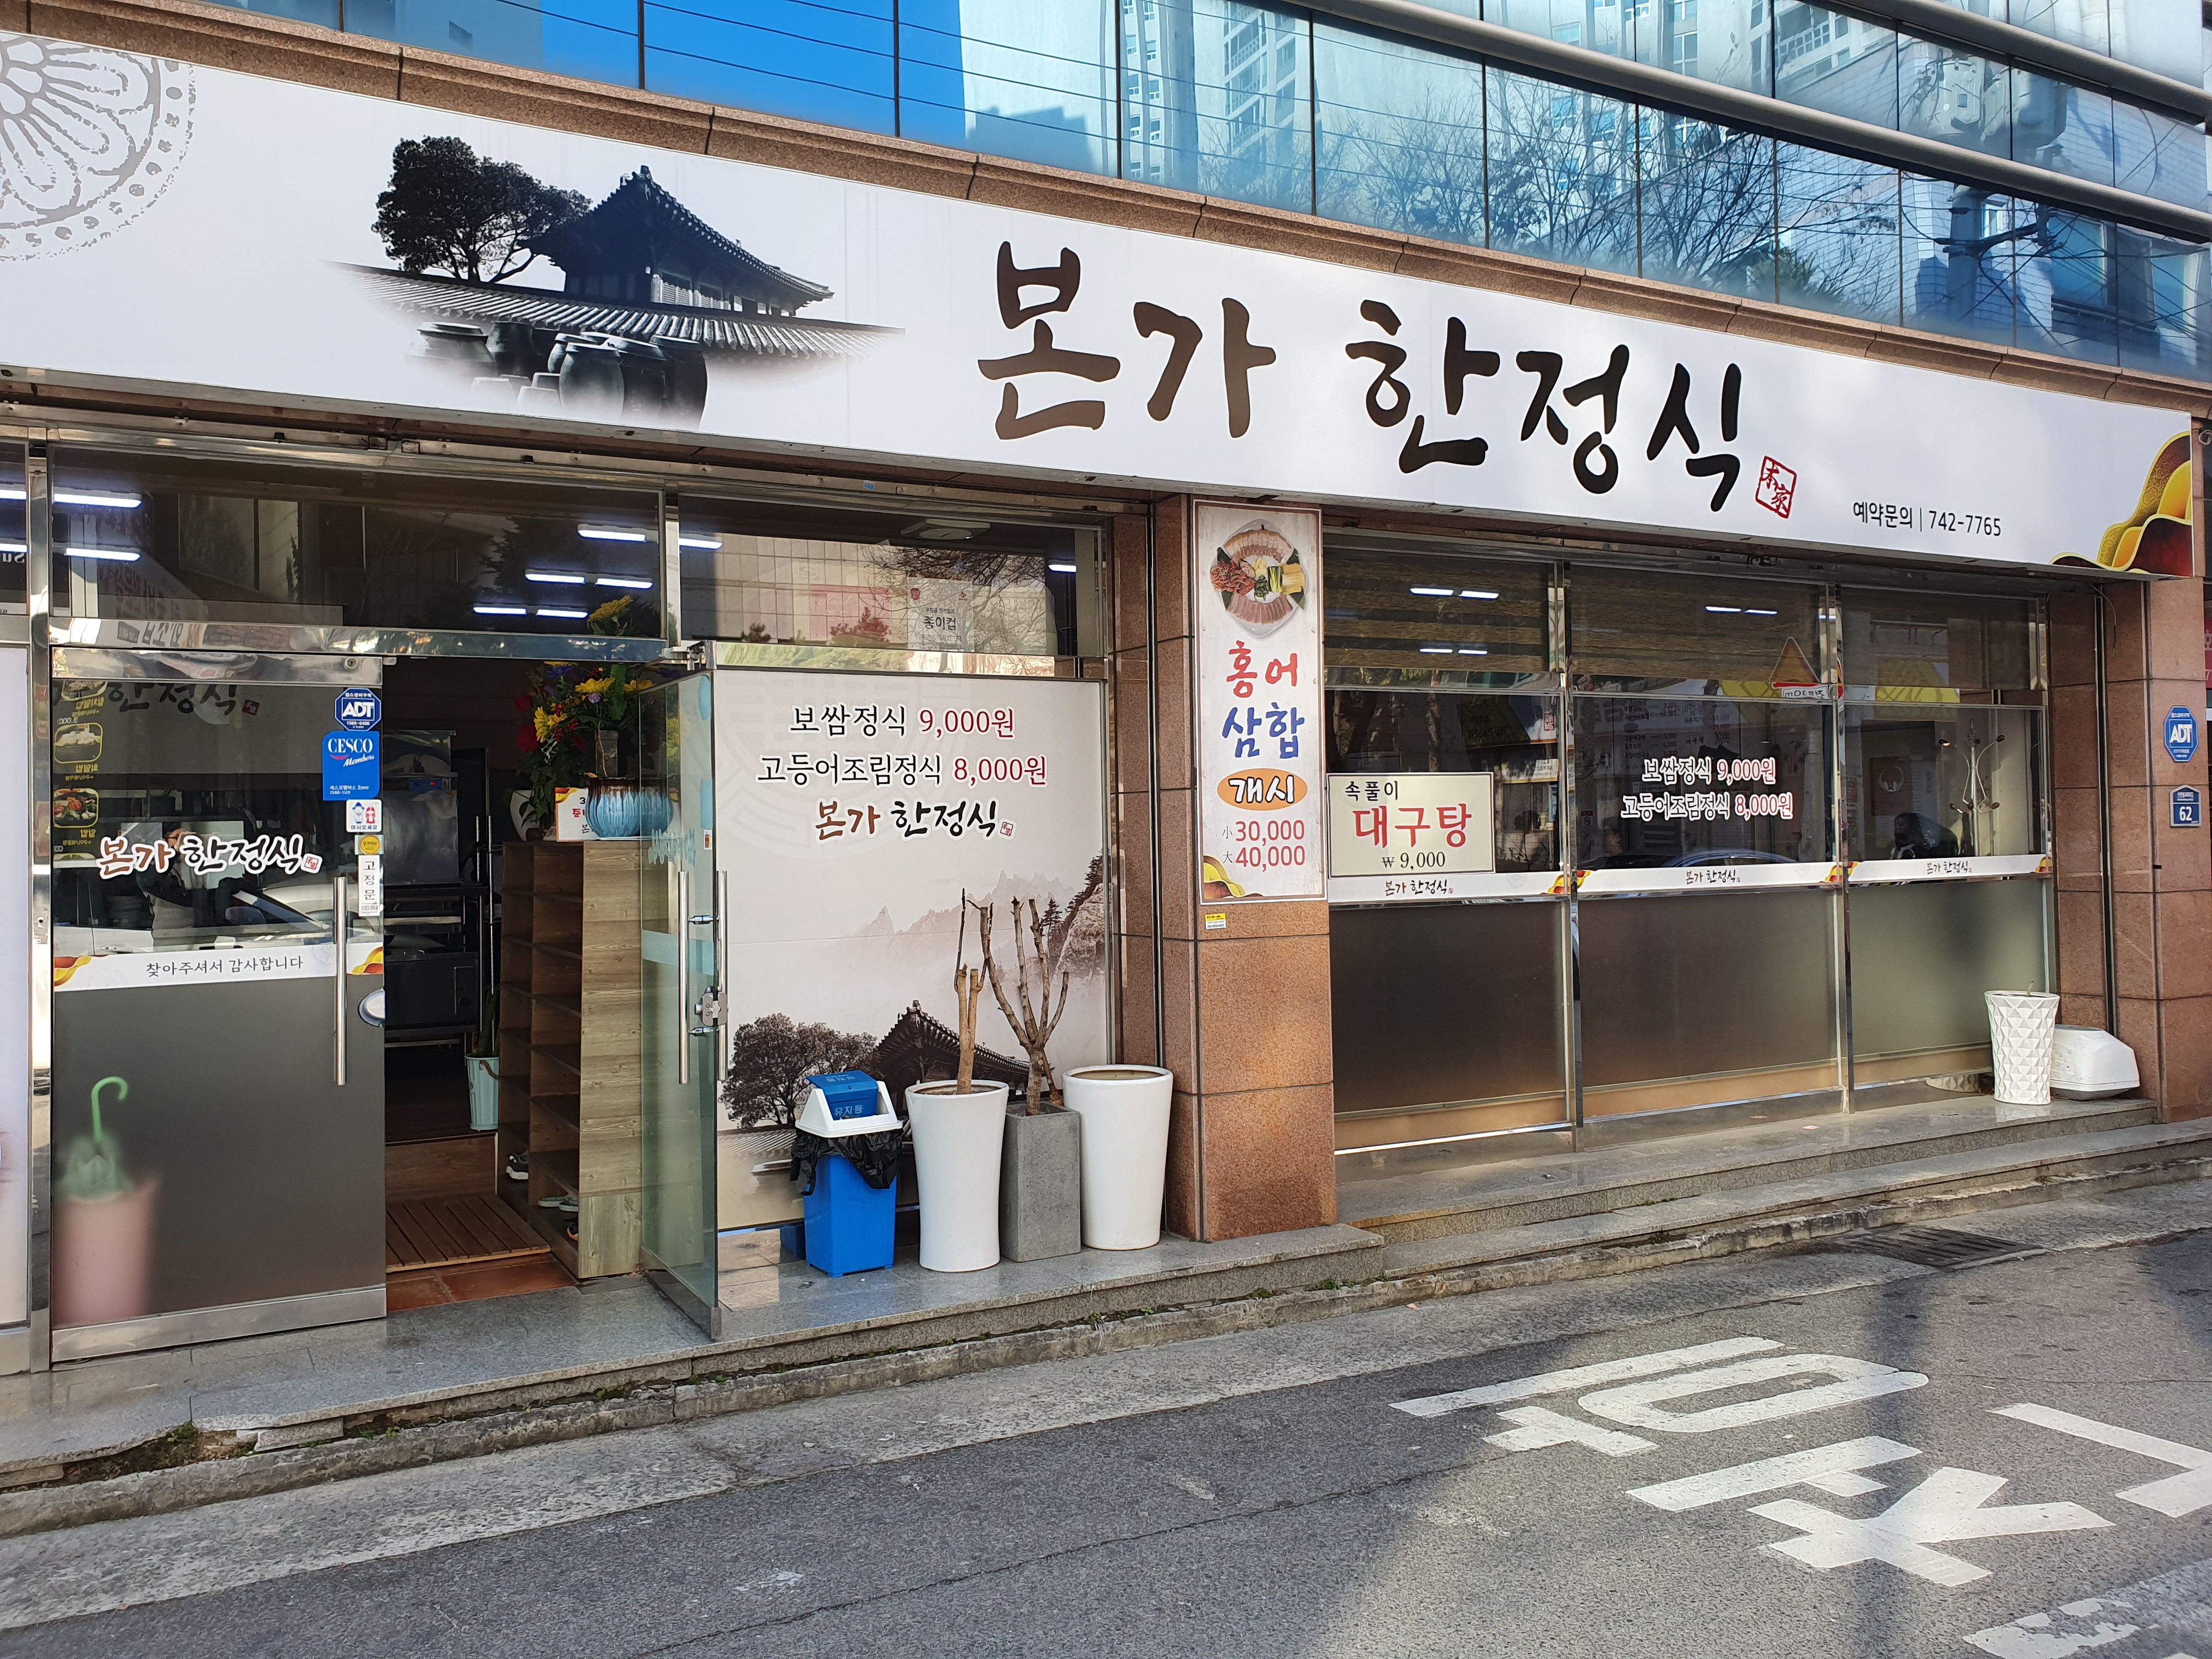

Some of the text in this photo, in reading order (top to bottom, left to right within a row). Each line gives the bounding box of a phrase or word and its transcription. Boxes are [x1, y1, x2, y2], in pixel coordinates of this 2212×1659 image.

[978, 241, 1742, 513] 본가 한정식
[1853, 501, 2001, 537] 예약문의 742-7765
[923, 616, 956, 631] 종이컵
[1226, 640, 1299, 699] 홍어
[342, 702, 374, 718] ADT
[789, 704, 1015, 738] 보쌈정식 9,000원
[1222, 702, 1305, 759] 삼합
[2169, 724, 2193, 743] ADT
[328, 738, 373, 753] CESCO
[343, 753, 375, 767] Members
[757, 755, 1047, 787] 고등어조림정식 8,000원
[1643, 757, 1777, 786] 보쌈정식 9,000원
[1229, 776, 1295, 804] 개시
[1344, 780, 1400, 802] 속풀이
[816, 800, 999, 840] 본가 한정식
[1621, 792, 1793, 821] 고등어조림정식 8,000원
[2179, 806, 2193, 821] 62
[1222, 820, 1305, 847] 小 30,000
[1352, 803, 1472, 849] 대구탕
[98, 834, 304, 877] 본가 한정식
[1222, 845, 1306, 872] 大 40,000
[1400, 851, 1446, 871] 9,000
[1926, 860, 1969, 874] 본가 한정식
[364, 861, 376, 900] 고정문
[1384, 880, 1448, 895] 본가 한정식
[1685, 869, 1737, 885] 본가 한정식
[146, 956, 303, 977] 찾아주셔서 감사합니다
